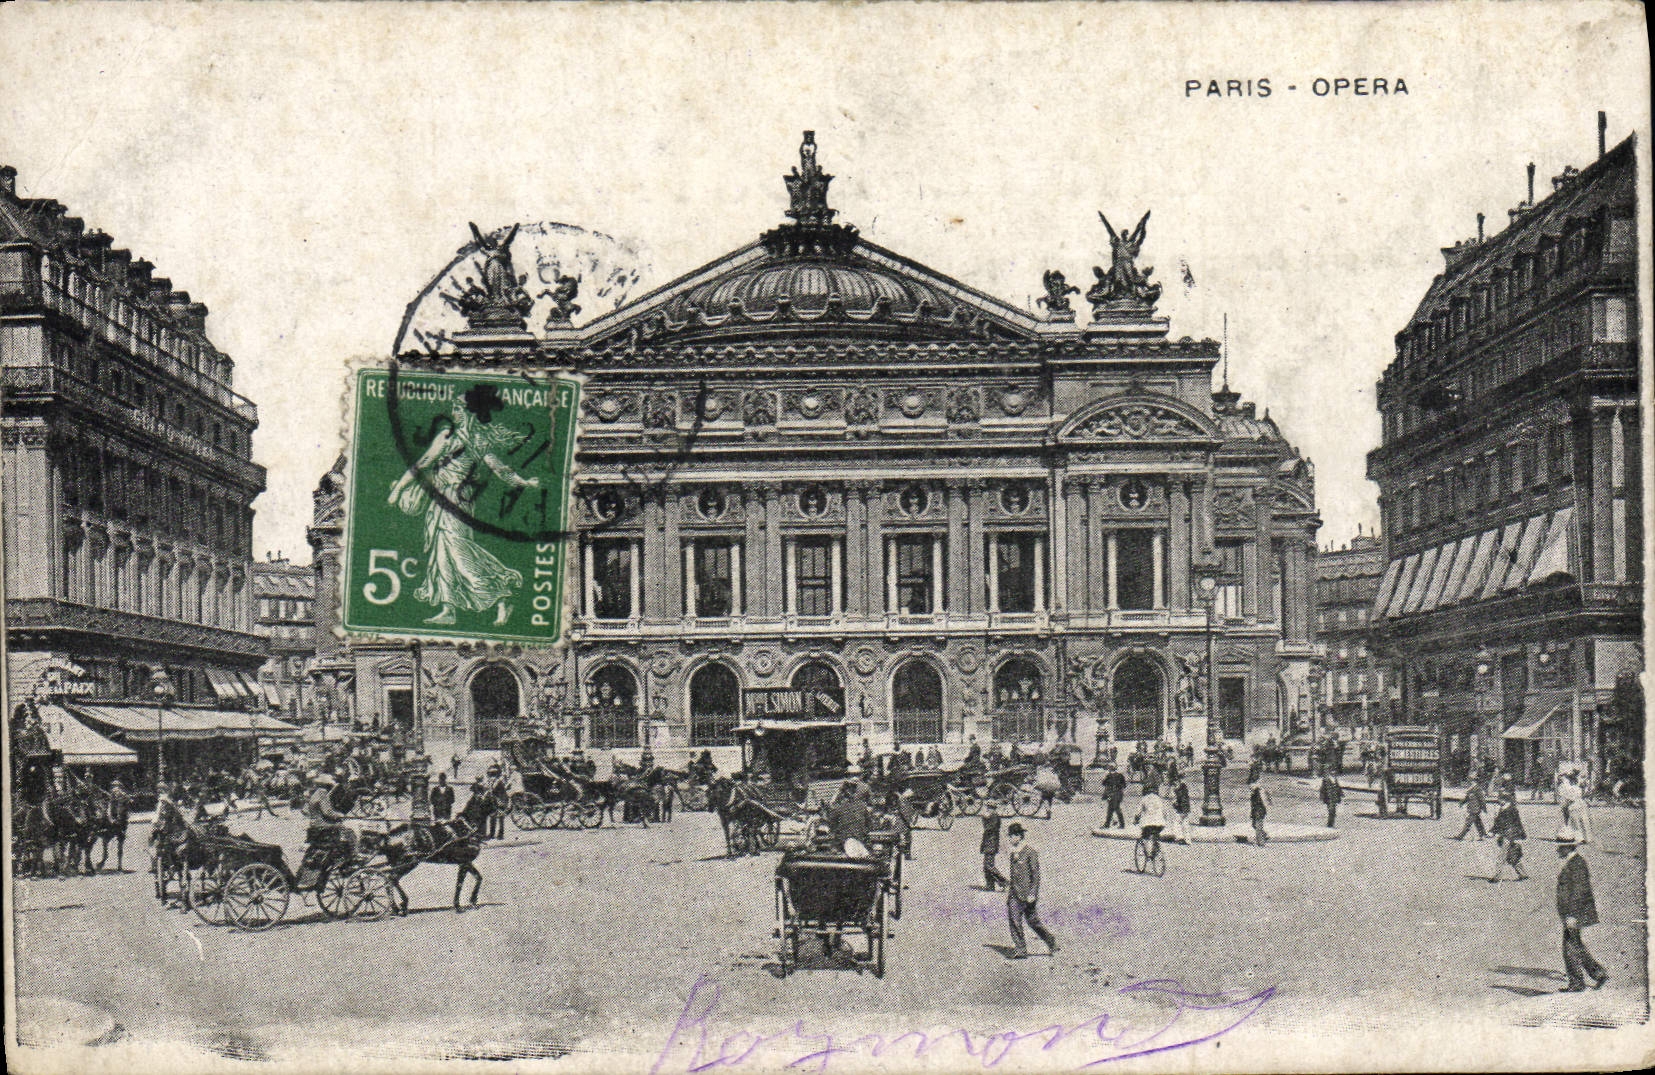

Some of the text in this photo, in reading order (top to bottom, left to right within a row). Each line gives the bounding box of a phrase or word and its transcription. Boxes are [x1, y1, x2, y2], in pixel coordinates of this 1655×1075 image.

[366, 378, 569, 409] REUBLIQUE ANÇAIE
[531, 543, 555, 626] POSTES
